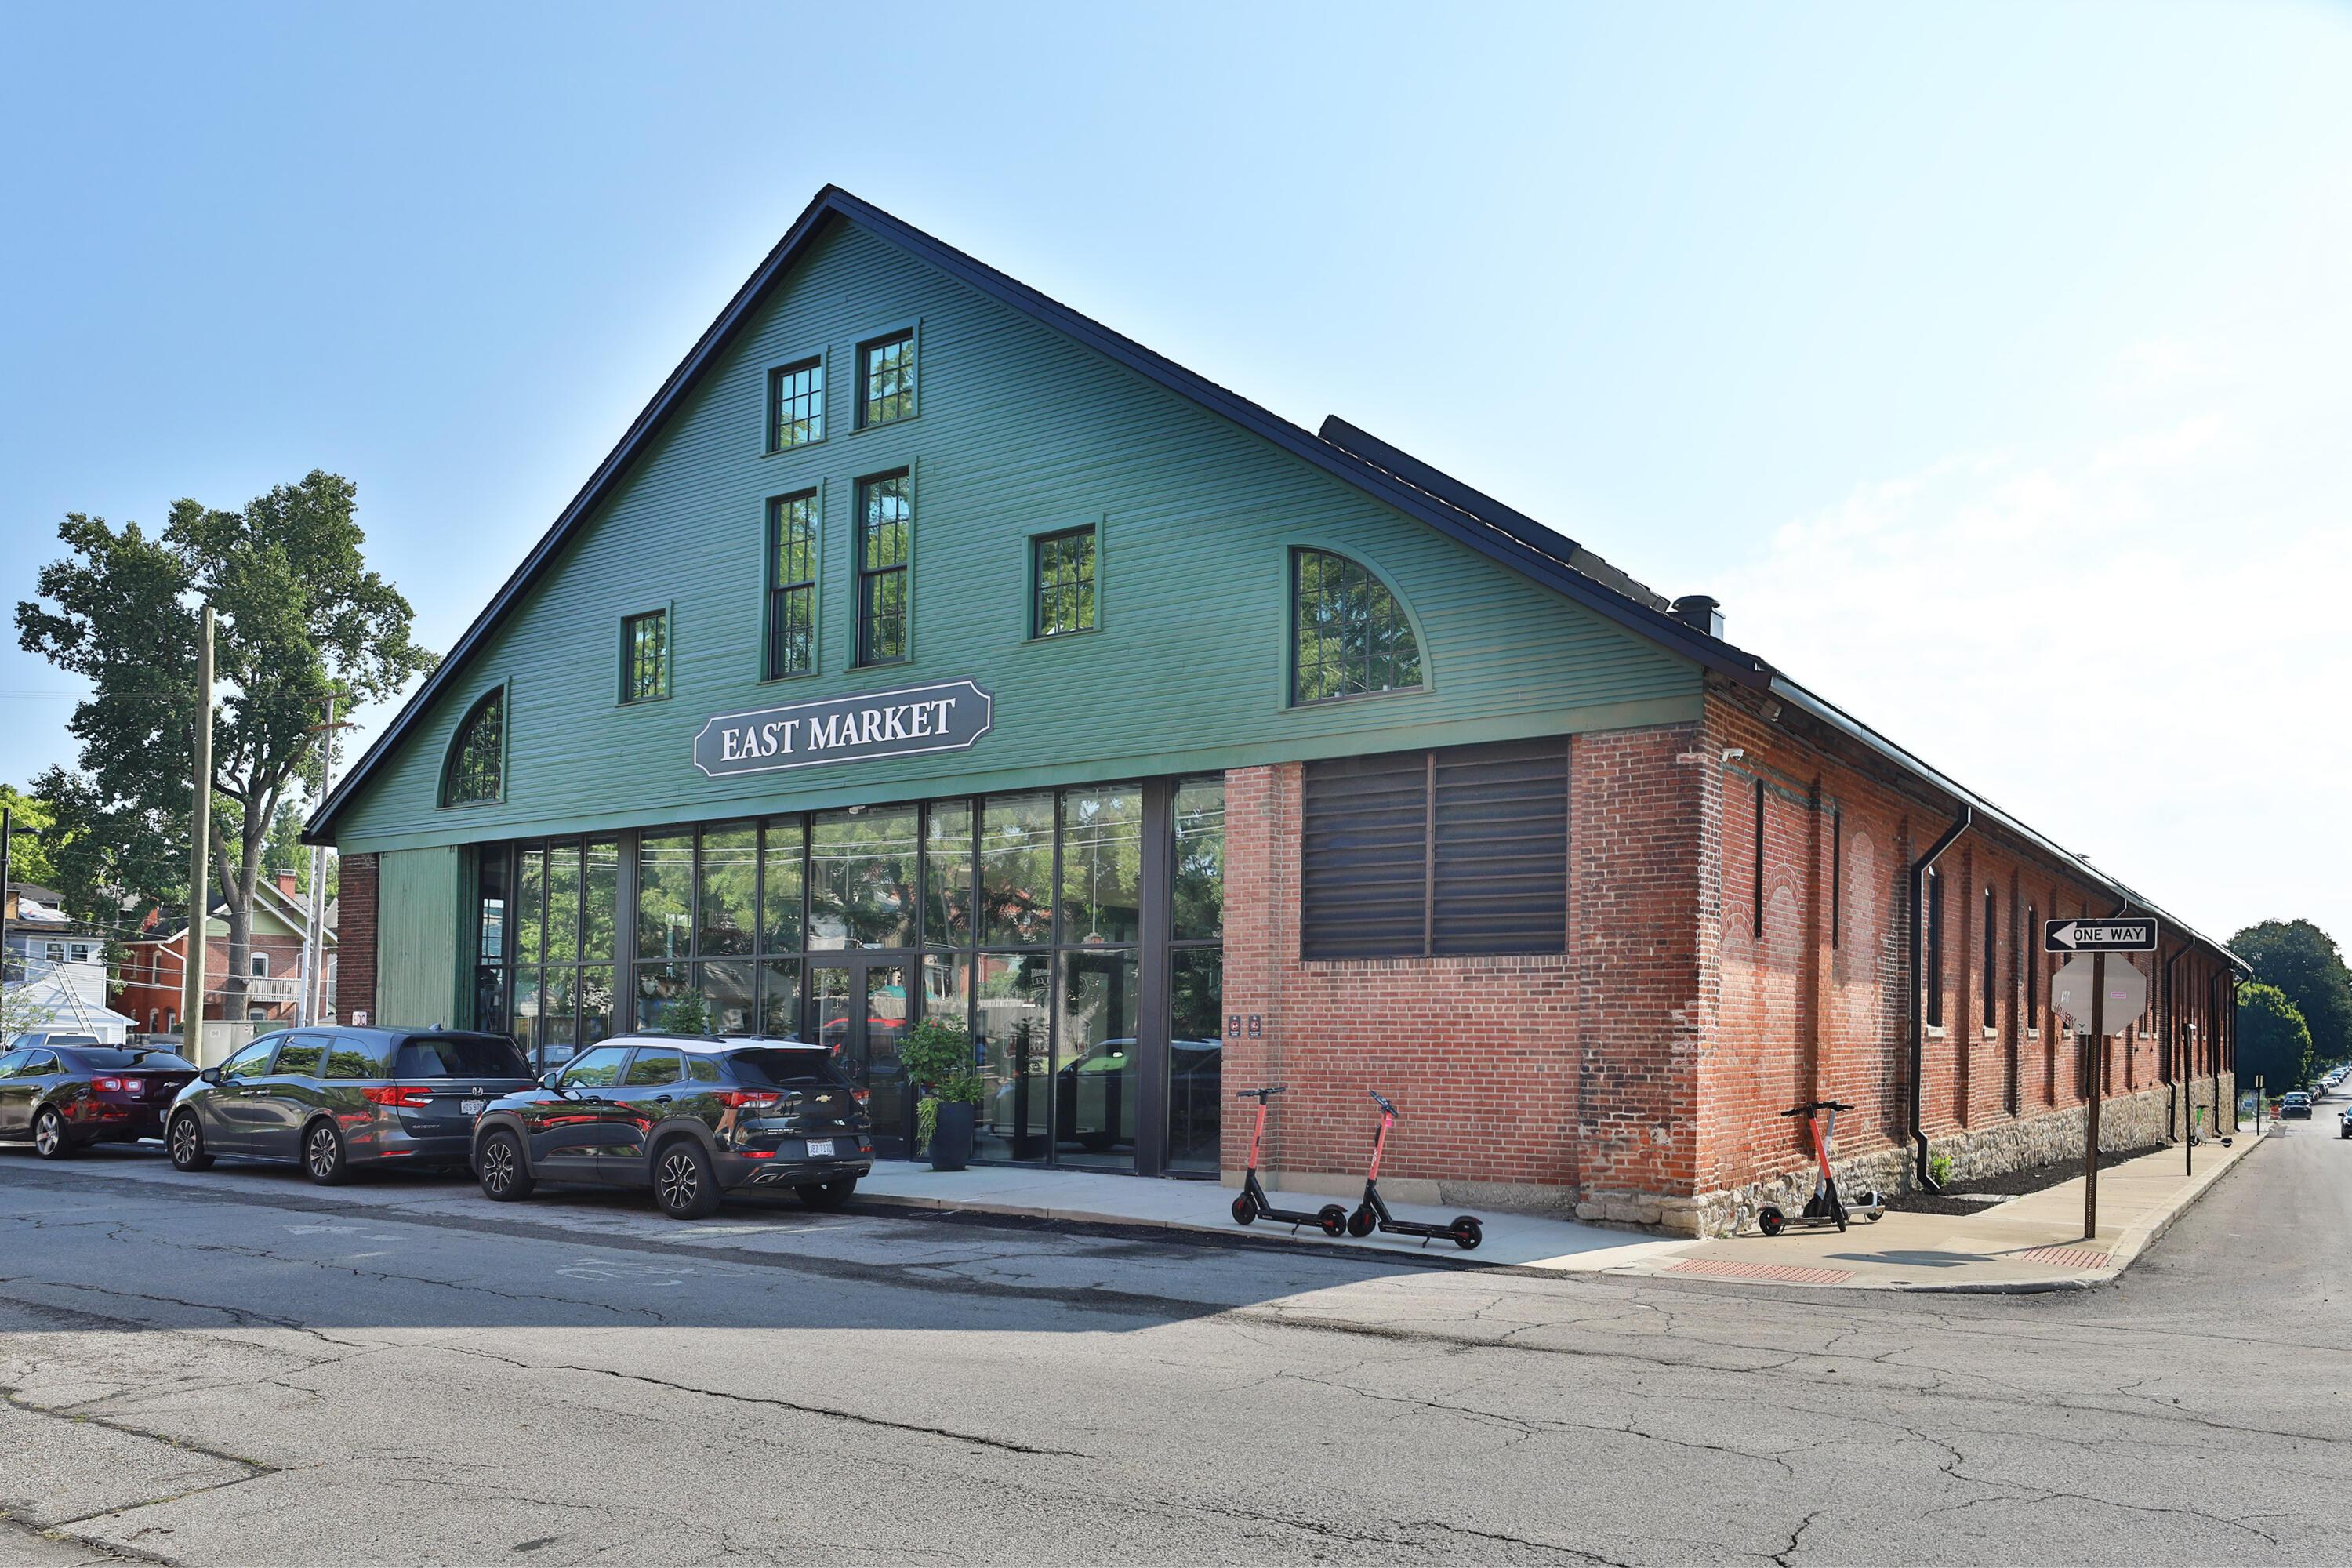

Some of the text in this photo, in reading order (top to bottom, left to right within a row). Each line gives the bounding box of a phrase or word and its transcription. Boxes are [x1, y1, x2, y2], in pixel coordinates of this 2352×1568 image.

[720, 697, 956, 762] EAST MARKET
[2073, 927, 2143, 941] ONE WAY
